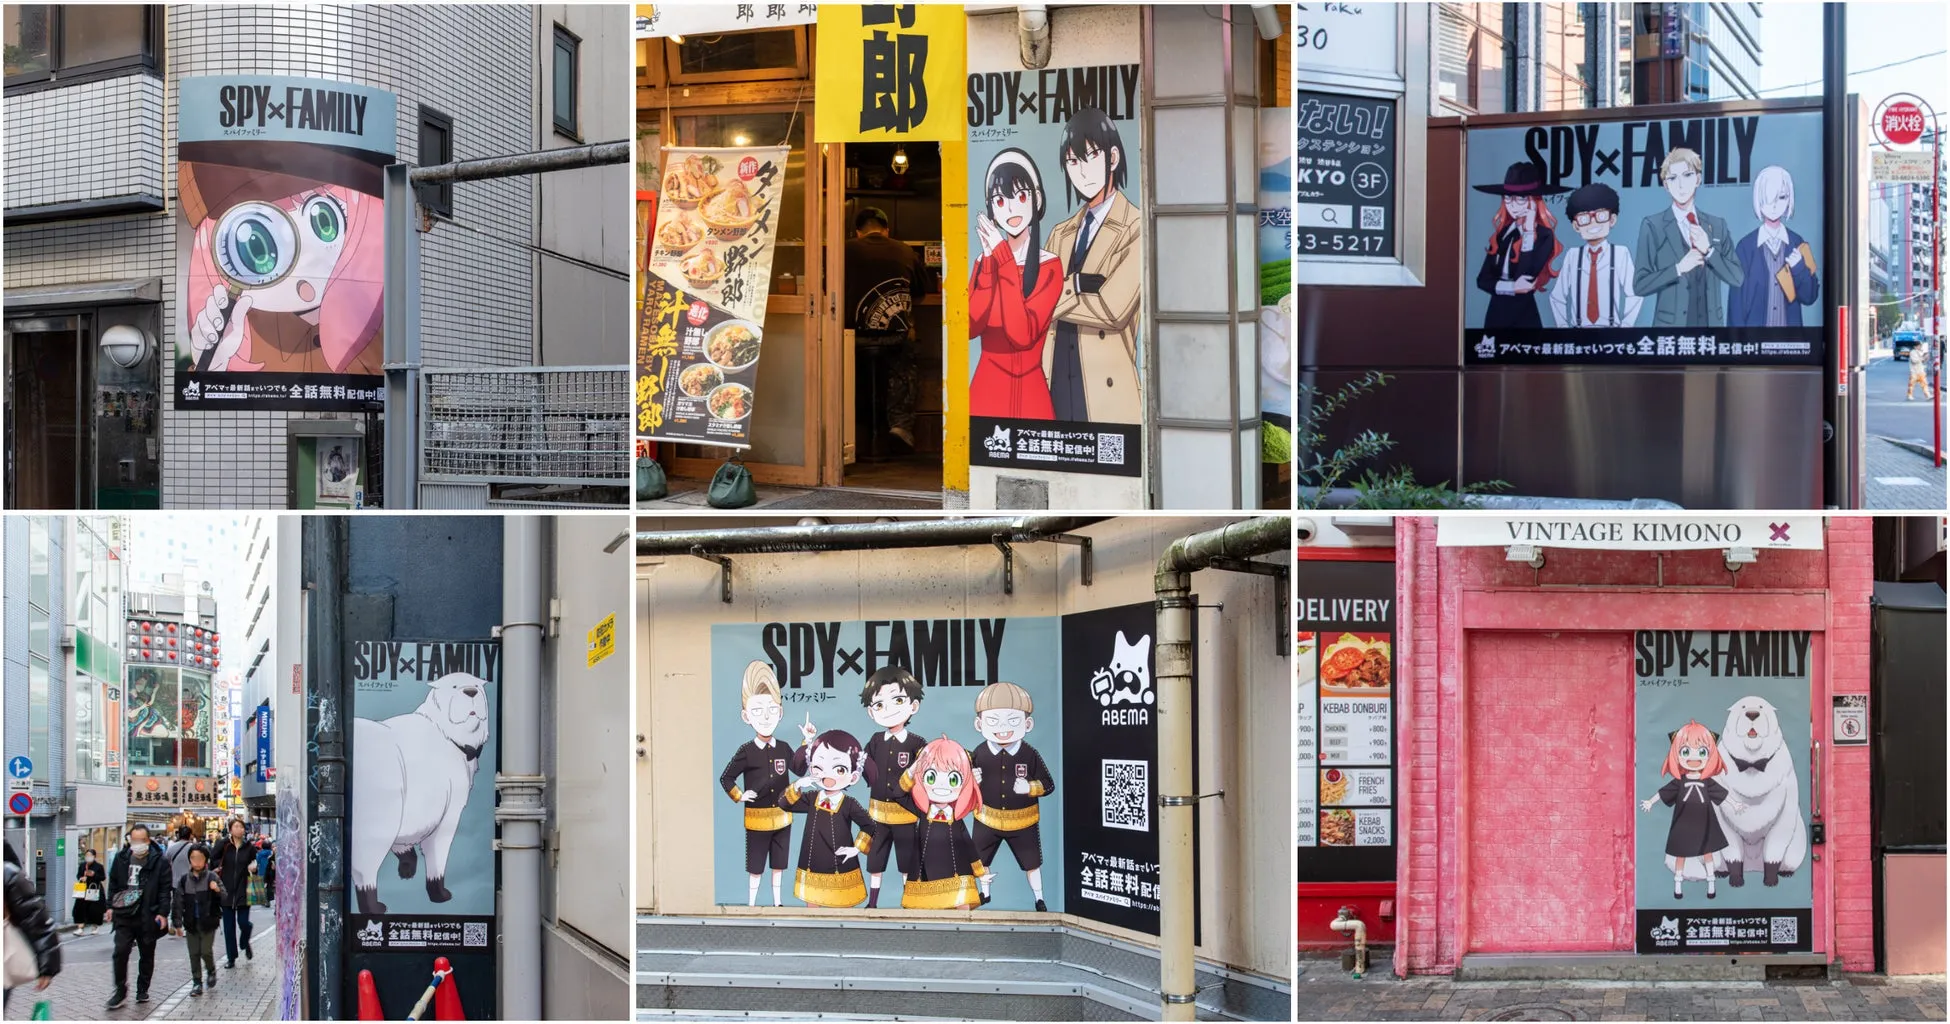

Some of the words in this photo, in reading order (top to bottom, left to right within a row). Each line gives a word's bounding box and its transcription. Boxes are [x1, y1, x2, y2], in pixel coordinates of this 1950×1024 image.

[860, 4, 929, 134] 郎
[219, 85, 368, 136] SPY×FAMILY
[1884, 114, 1922, 132] 消火栓
[971, 128, 1019, 138] スパイファミリー
[1298, 168, 1346, 186] KYO
[1357, 173, 1382, 189] 3F
[1637, 335, 1759, 356] 全話無料配信中!
[289, 384, 376, 400] 全話無料配信中!
[1017, 429, 1095, 441] アベマで最新話までいつでも
[1016, 438, 1095, 456] 全話無料配信中!
[1506, 521, 1624, 541] VINTAGE
[1633, 522, 1742, 542] KIMONO
[1635, 630, 1812, 677] SPY×FAMILY
[1323, 703, 1350, 714] KEBAB
[1352, 703, 1388, 714] DONBURI
[1102, 708, 1149, 726] ABEMA
[1359, 776, 1385, 785] FRENCH
[1359, 786, 1378, 795] FRIES
[1359, 817, 1381, 826] KEBAB
[1359, 826, 1386, 835] SNACKS
[388, 929, 462, 941] 全話無料配信中!
[1686, 926, 1768, 939] 全話無料配信中!
